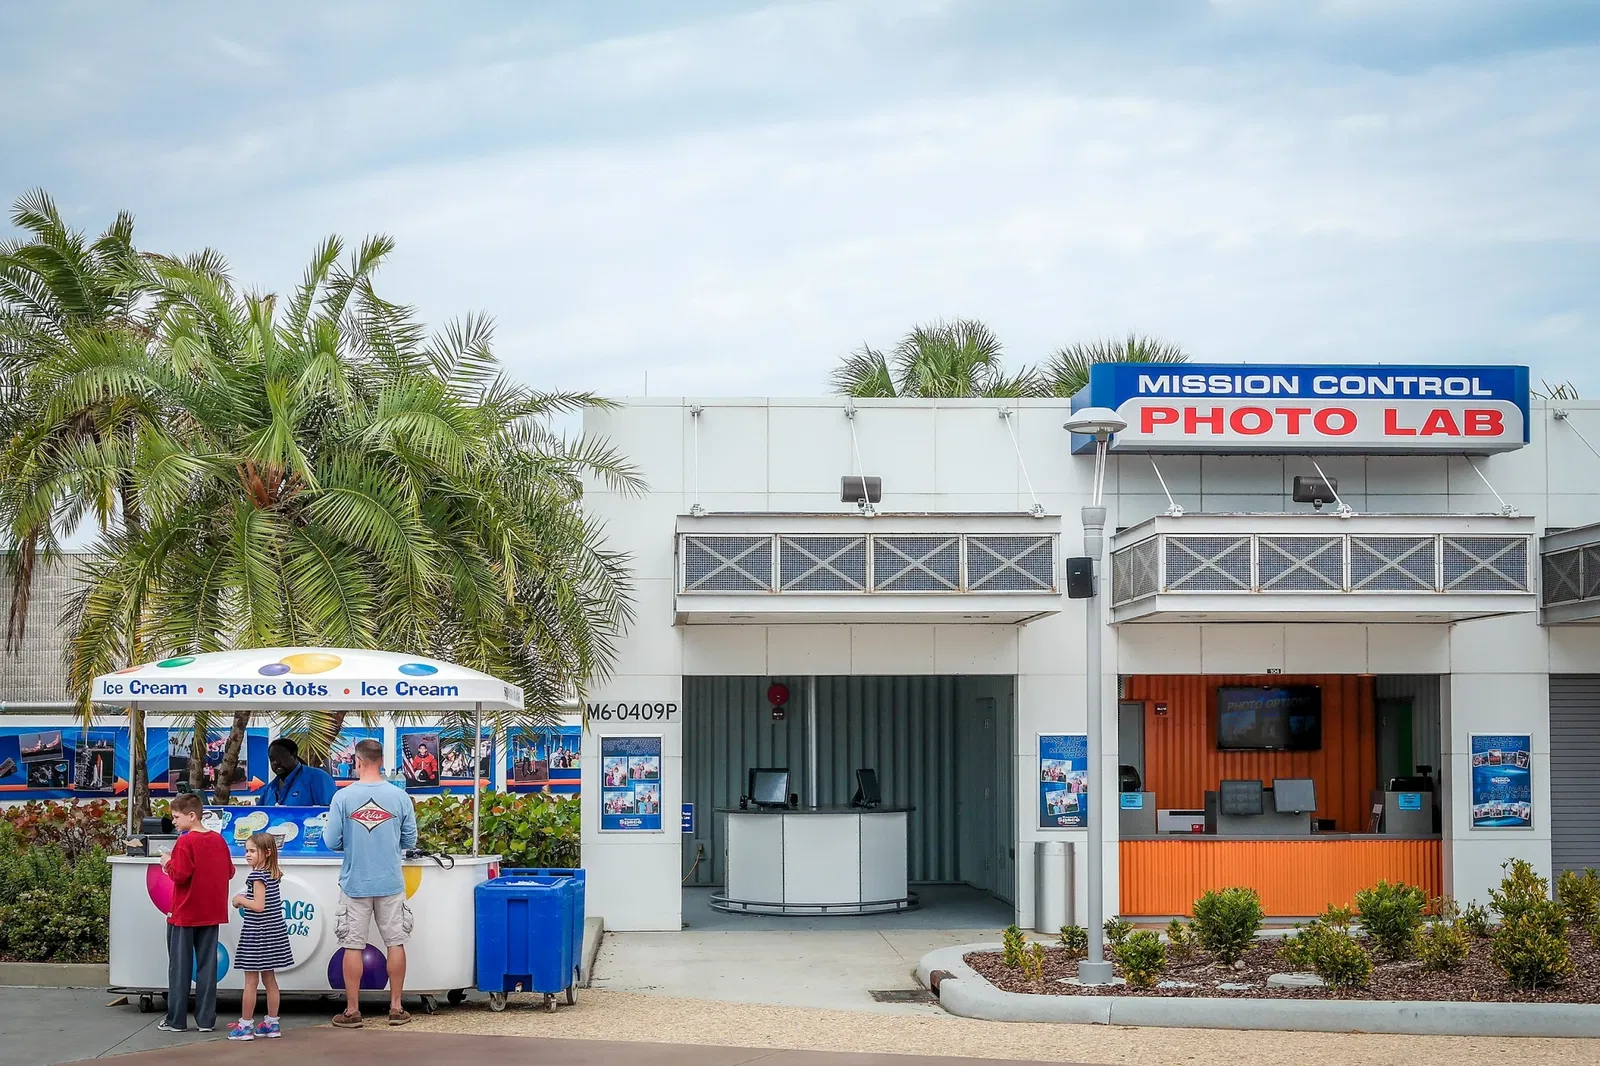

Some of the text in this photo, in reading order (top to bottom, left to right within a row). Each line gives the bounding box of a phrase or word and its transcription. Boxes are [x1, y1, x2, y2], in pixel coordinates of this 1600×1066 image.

[1138, 374, 1492, 396] MISSION CONTROL
[1140, 406, 1504, 437] PHOTO LAB
[102, 679, 459, 698] Ice Cream space dots Ice Cream
[587, 703, 678, 721] M6-0409P
[358, 810, 384, 820] Relax
[286, 920, 310, 937] ots
